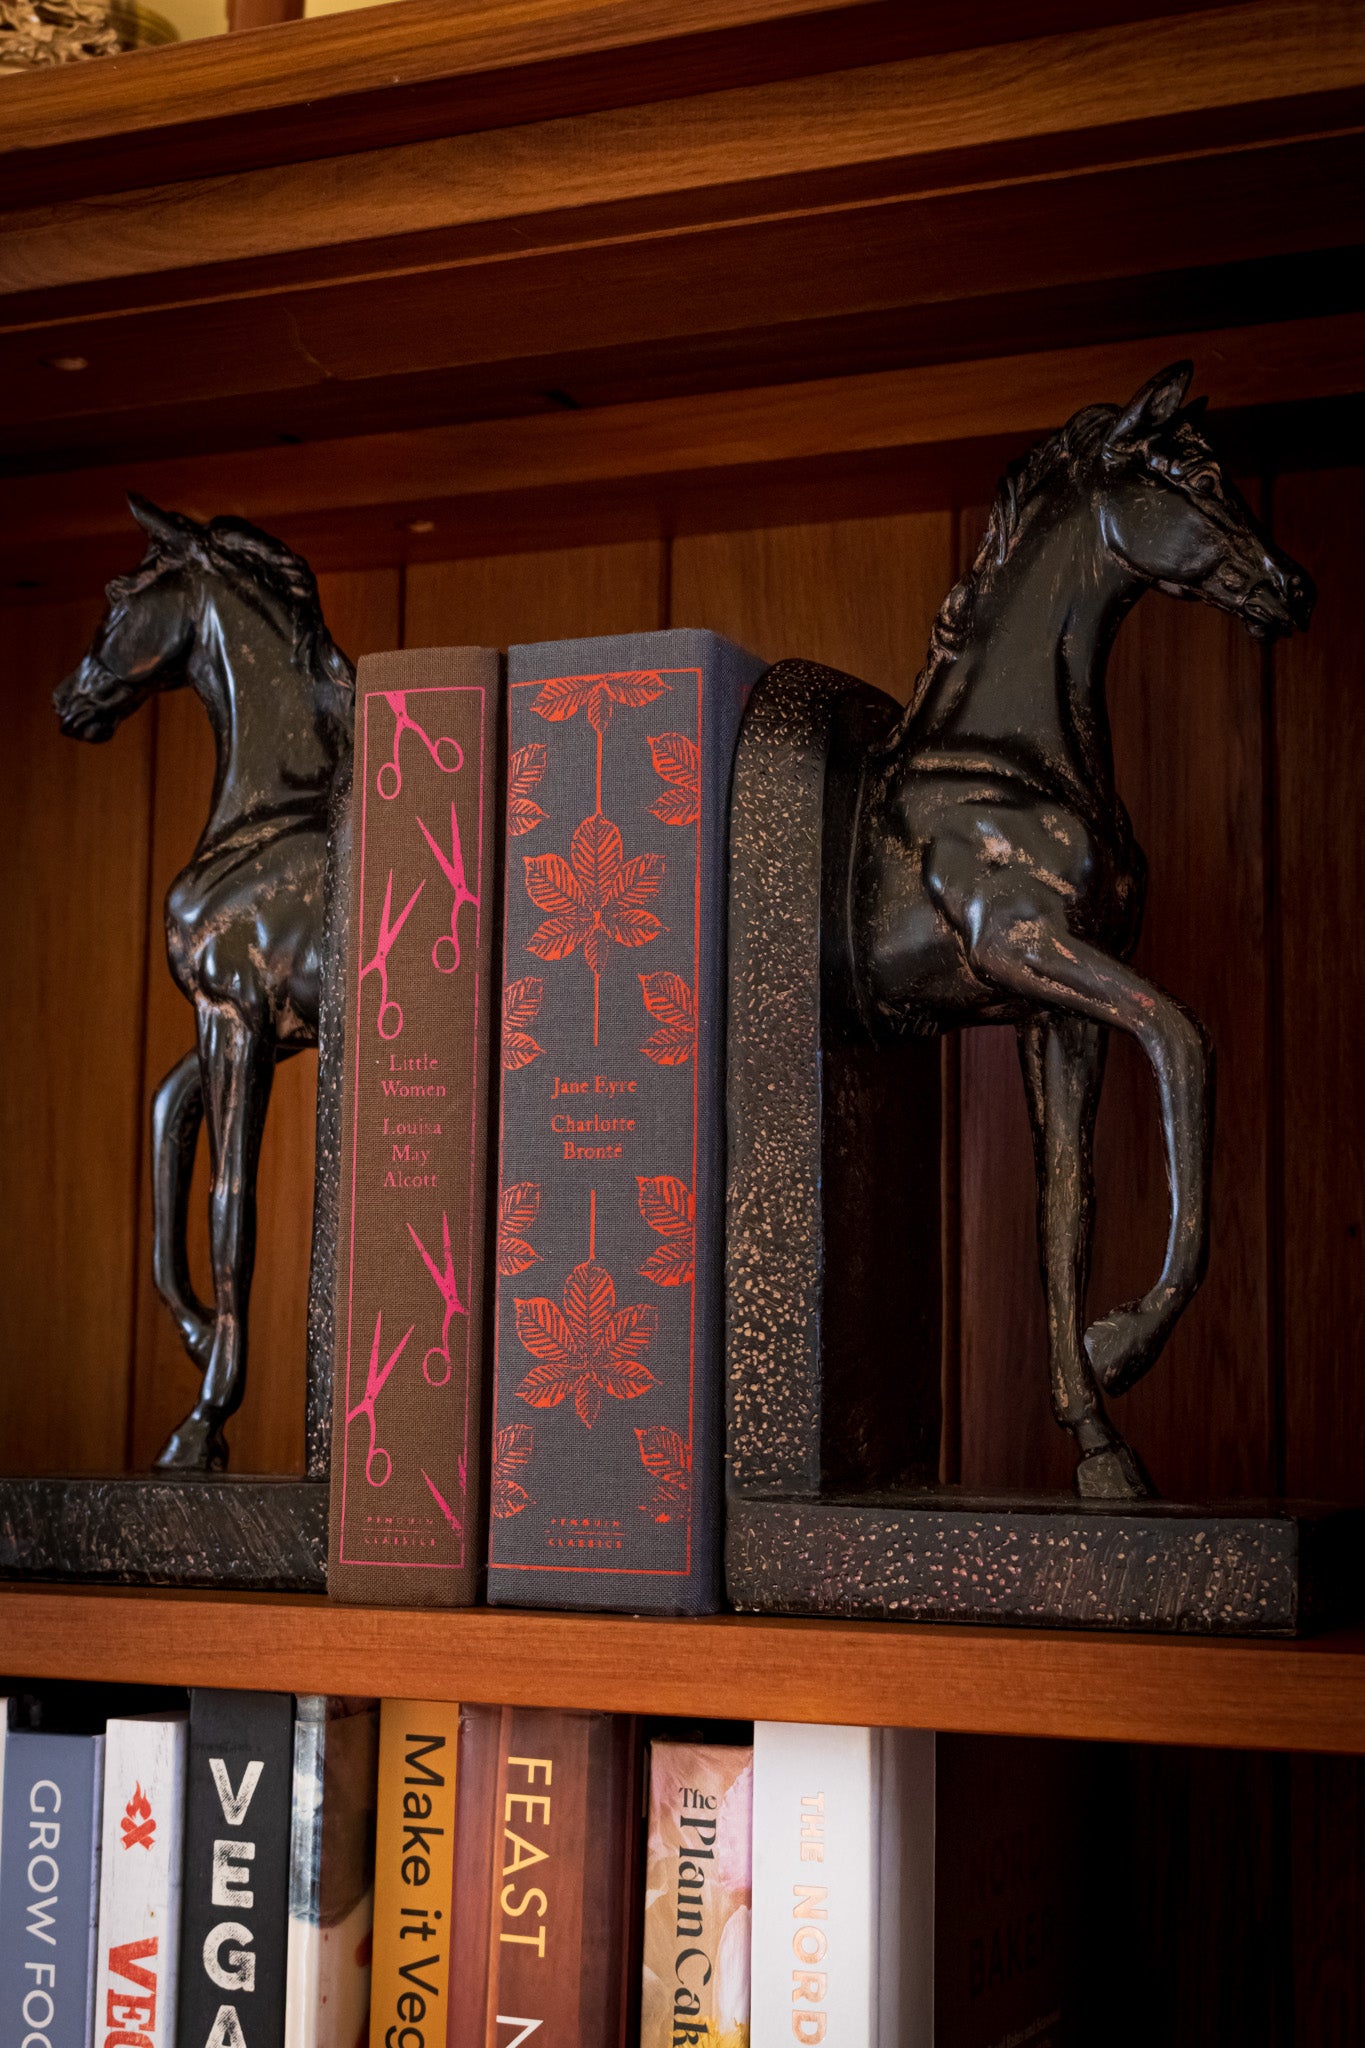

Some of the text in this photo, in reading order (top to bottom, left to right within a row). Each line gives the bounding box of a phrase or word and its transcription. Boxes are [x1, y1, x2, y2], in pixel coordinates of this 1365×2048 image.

[389, 1052, 439, 1071] Little
[380, 1079, 447, 1097] Women
[551, 1075, 637, 1100] Jane Eyre
[383, 1117, 442, 1134] Louisa
[551, 1113, 636, 1133] Charlotte
[392, 1144, 431, 1167] May
[383, 1170, 438, 1188] Alcott
[548, 1537, 622, 1549] CLASSICS
[400, 1733, 446, 1887] Make
[678, 1787, 718, 1810] The
[25, 1779, 62, 1946] GROW
[499, 1756, 552, 1958] FEAST
[676, 1815, 717, 1938] Plain
[203, 1758, 264, 2048] VEGA
[399, 1908, 443, 1941] it
[792, 1791, 828, 2045] THE NORD
